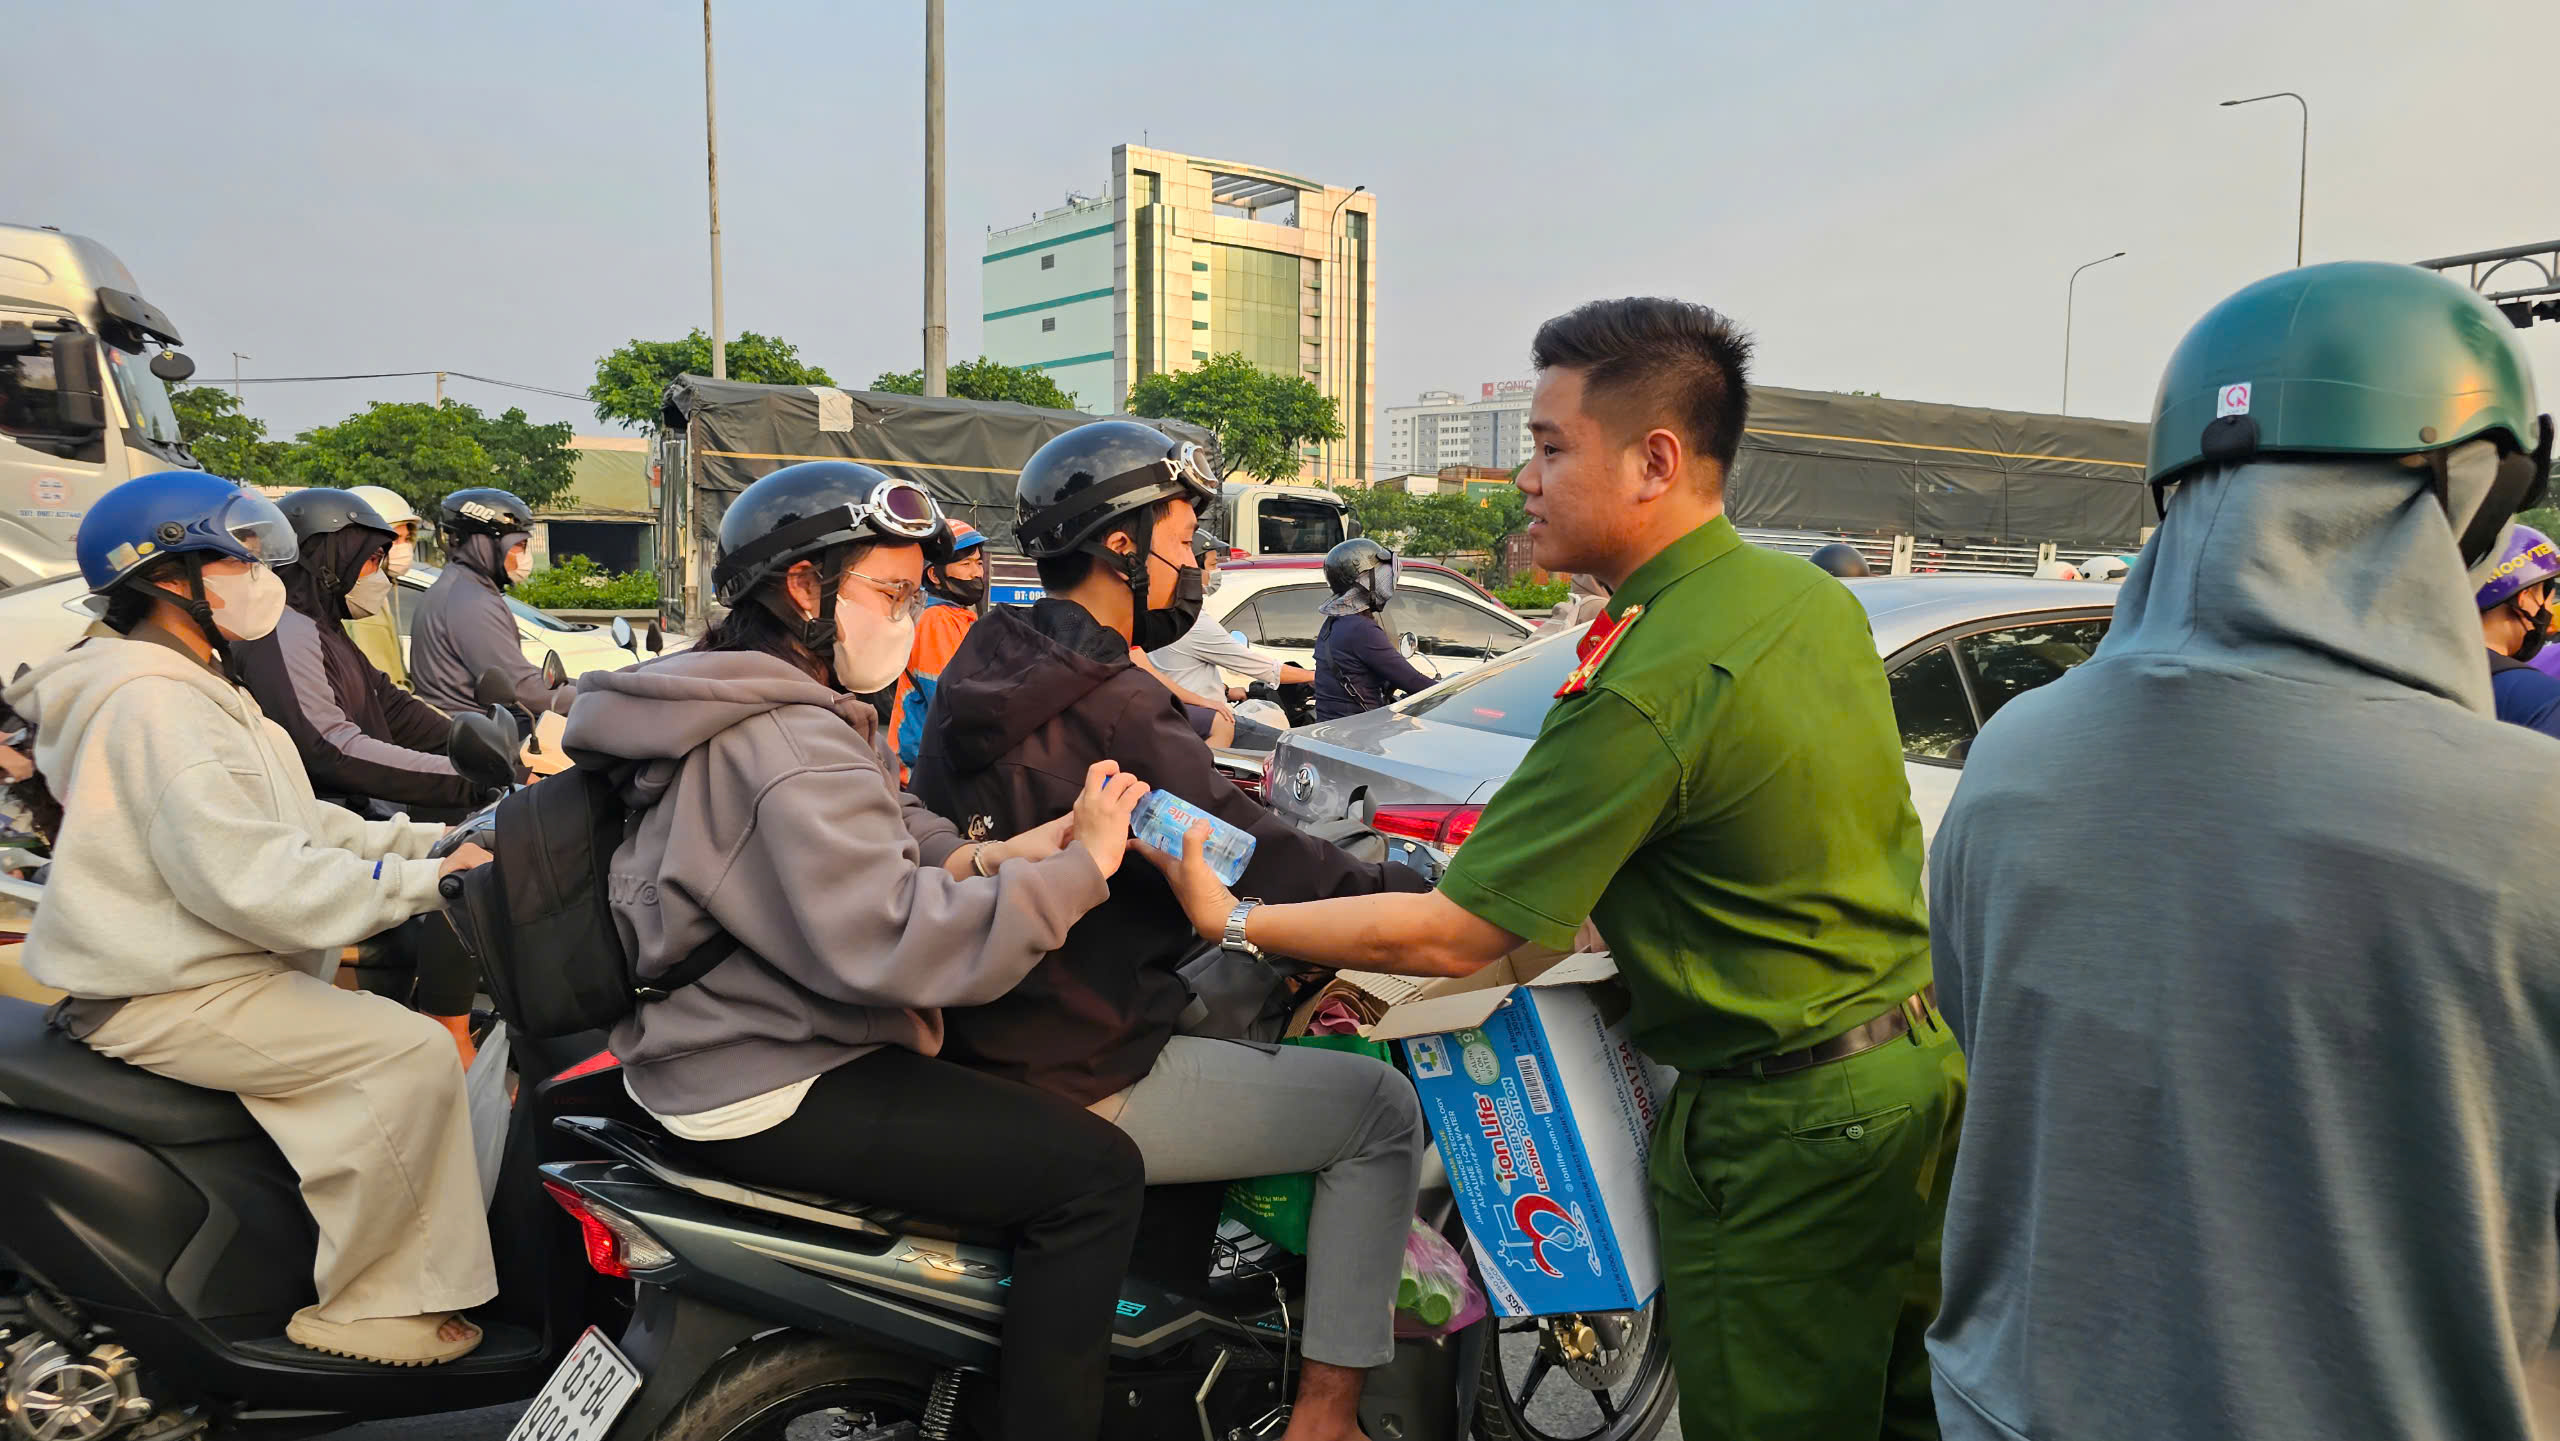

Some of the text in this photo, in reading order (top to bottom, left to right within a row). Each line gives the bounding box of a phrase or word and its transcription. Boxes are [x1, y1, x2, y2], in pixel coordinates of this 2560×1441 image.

[1593, 1013, 1606, 1042] MINH
[1481, 1051, 1493, 1076] WATER
[1618, 1041, 1639, 1085] 1734
[1502, 1078, 1531, 1138] POSITION
[1633, 1086, 1654, 1130] 1900
[1436, 1098, 1484, 1224] JAPAN ADVANCED TECHNOLOGY
[1440, 1130, 1451, 1155] VALUE
[1448, 1111, 1486, 1207] ALKALINE I-ON WATER
[1496, 1098, 1532, 1178] ASSERT OUR
[1525, 1140, 1548, 1190] LEADING
[1506, 1294, 1523, 1314] SGS
[562, 1346, 624, 1426] 63-B4
